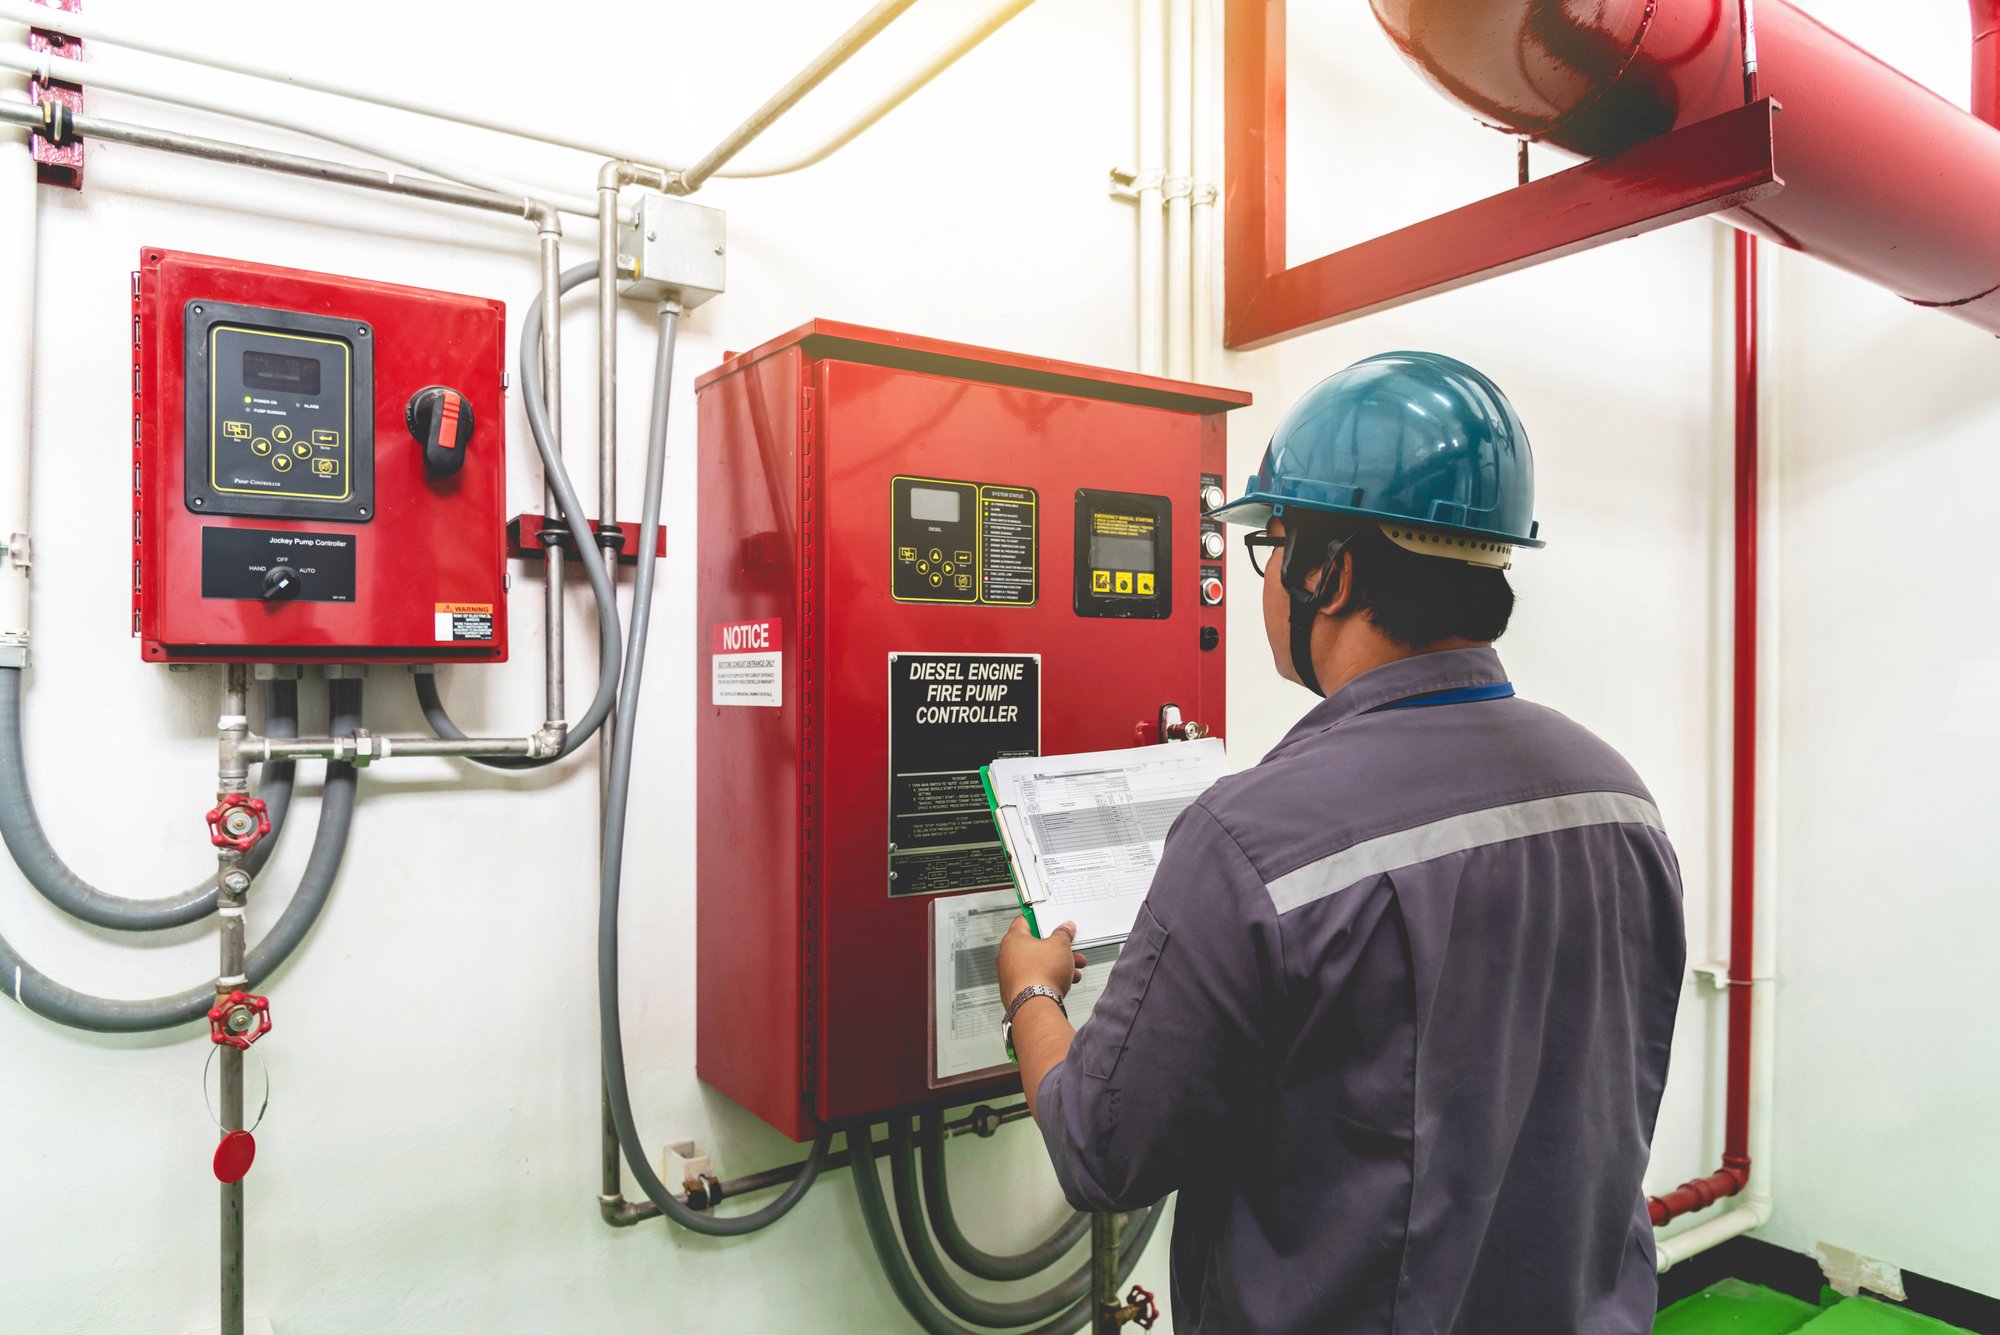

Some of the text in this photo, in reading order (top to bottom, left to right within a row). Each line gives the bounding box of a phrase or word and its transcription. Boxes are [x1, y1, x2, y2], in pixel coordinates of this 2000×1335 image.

[269, 537, 293, 546] Jockey
[294, 538, 314, 546] Pump
[724, 623, 769, 650] NOTICE
[910, 662, 1024, 680] DIESEL ENGINE
[927, 685, 1008, 702] FIRE PUMP
[916, 706, 1018, 724] CONTROLLER
